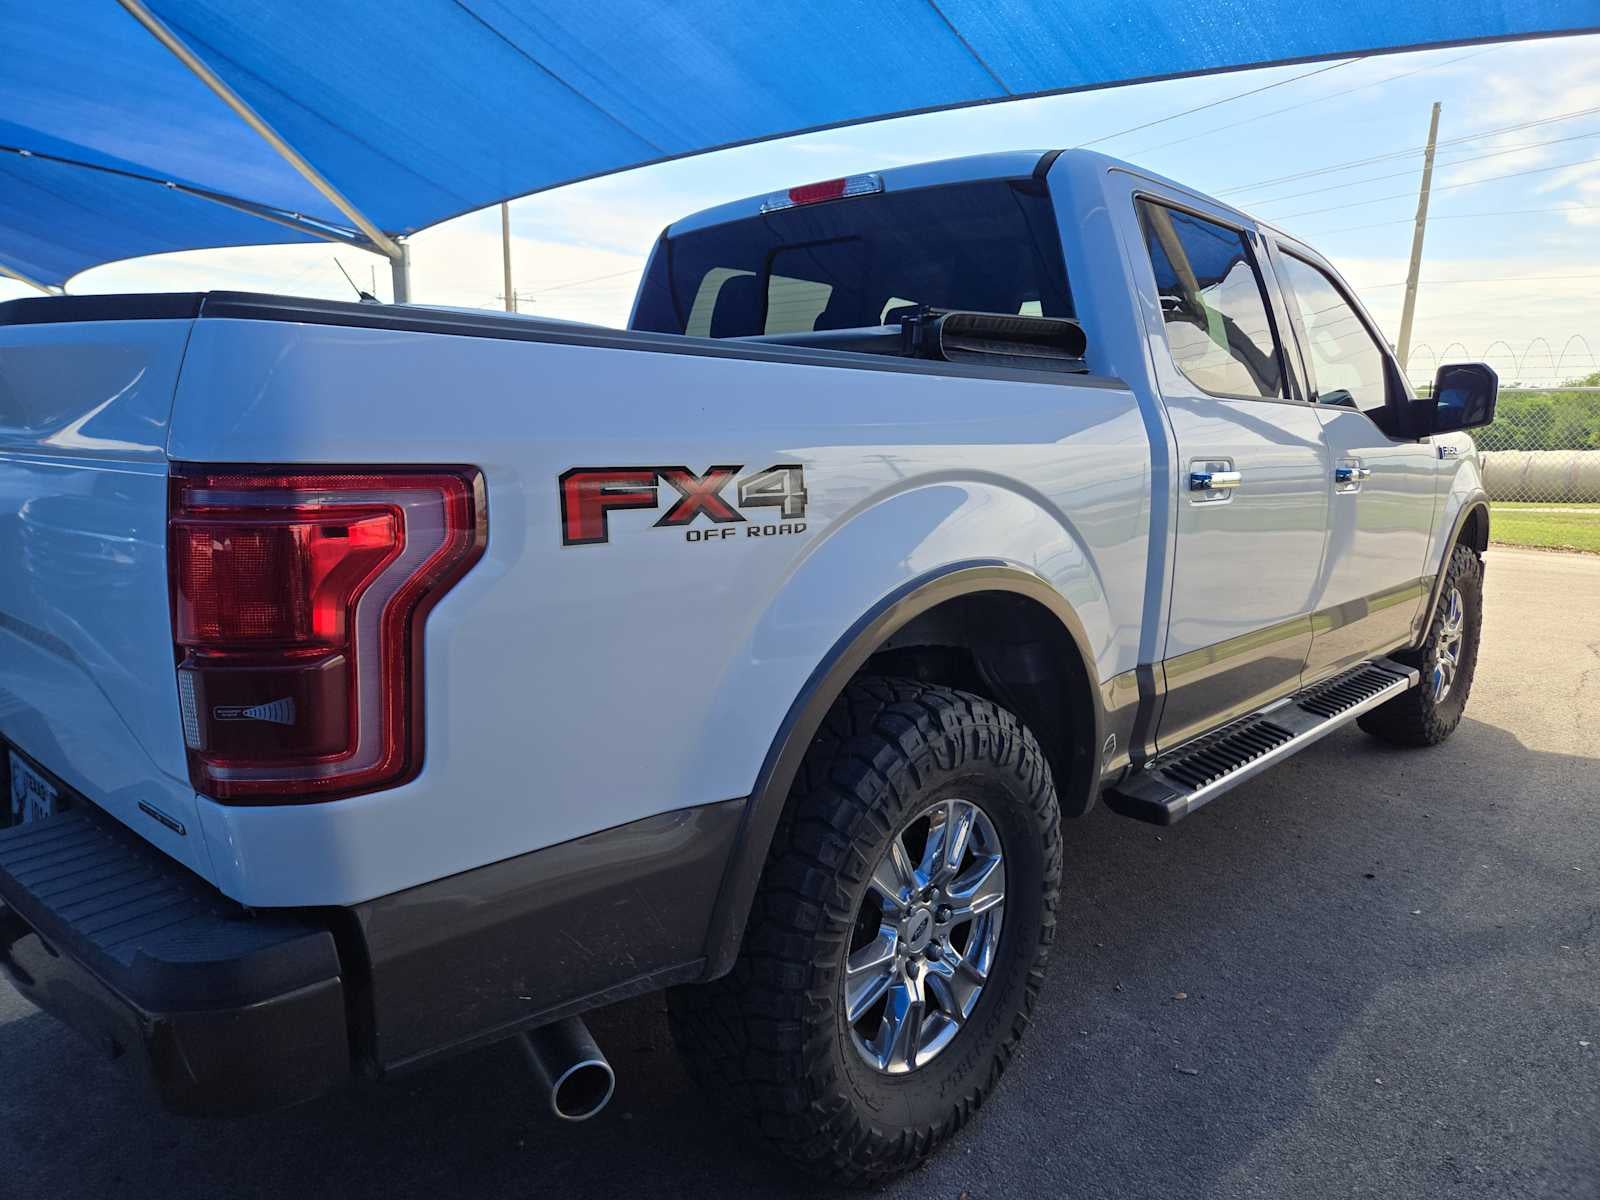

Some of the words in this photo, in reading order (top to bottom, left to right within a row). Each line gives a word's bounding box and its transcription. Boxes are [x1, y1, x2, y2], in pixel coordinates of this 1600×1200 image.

[559, 464, 807, 546] FX4
[686, 528, 736, 542] OFF
[747, 523, 808, 538] ROAD
